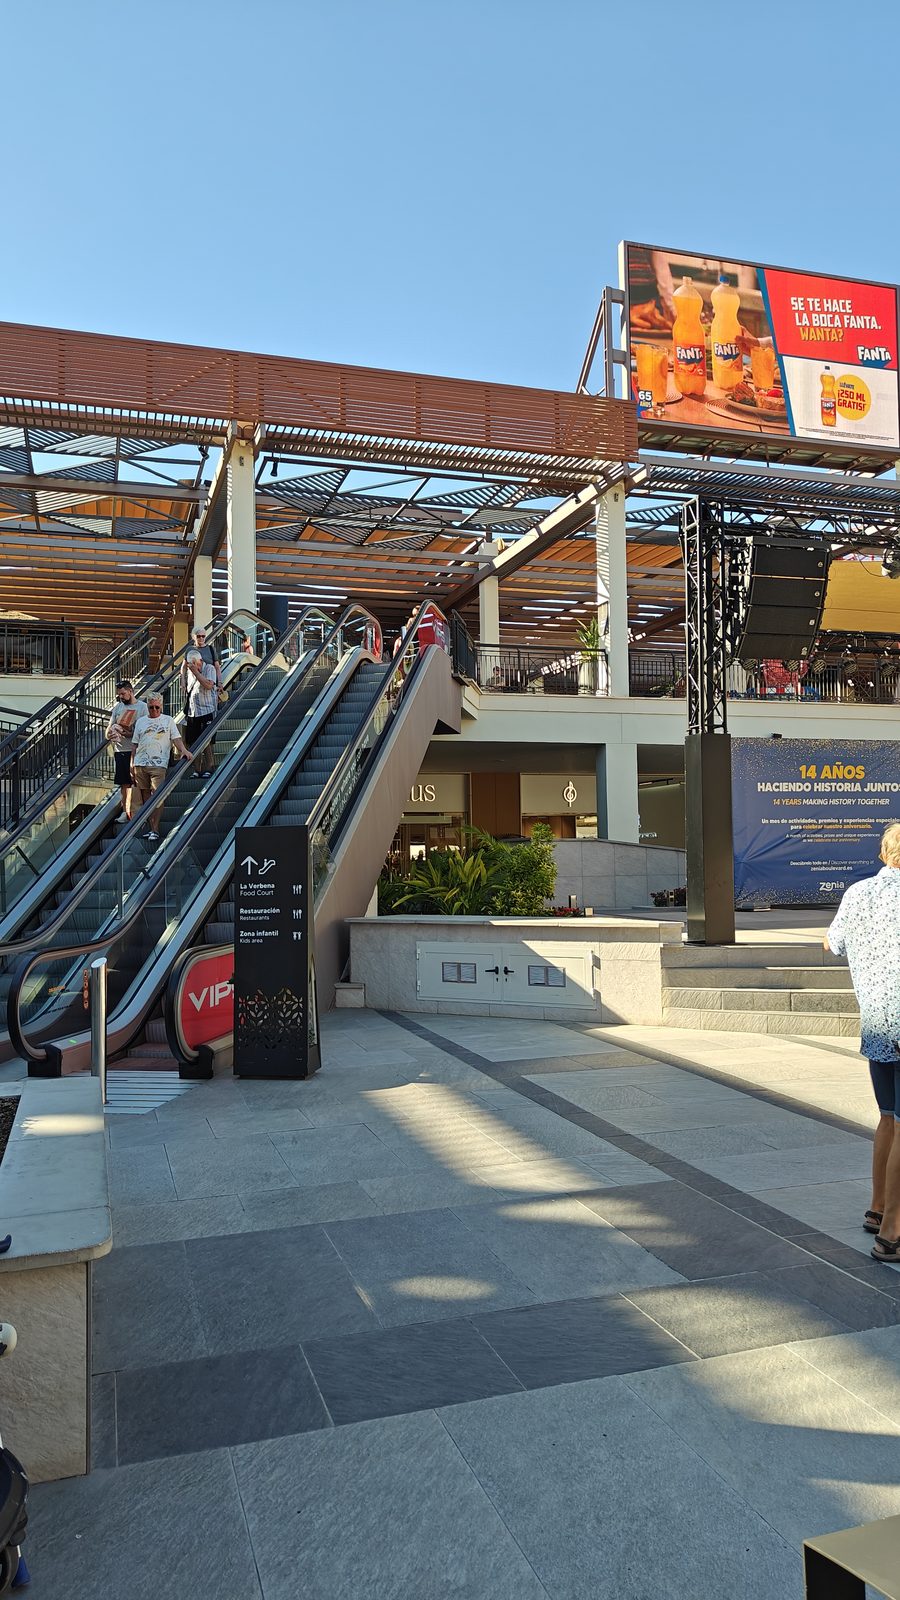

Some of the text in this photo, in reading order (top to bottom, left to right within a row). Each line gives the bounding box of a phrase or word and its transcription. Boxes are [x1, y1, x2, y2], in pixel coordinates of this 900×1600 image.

[790, 296, 852, 313] SE TE HACE
[795, 312, 882, 330] LA BOCA FANTA.
[799, 327, 844, 342] WANTA?
[676, 346, 703, 360] FANTA
[714, 342, 739, 356] FANTA
[857, 345, 892, 361] FANTA
[638, 390, 652, 401] 65
[837, 389, 866, 402] ¡250 ML
[837, 398, 867, 411] GRATIS!
[799, 761, 865, 779] 14 AÑOS
[757, 782, 900, 792] HACIENDO HISTORIA JUNTO
[819, 880, 845, 892] zenia
[188, 980, 234, 1012] VIP
